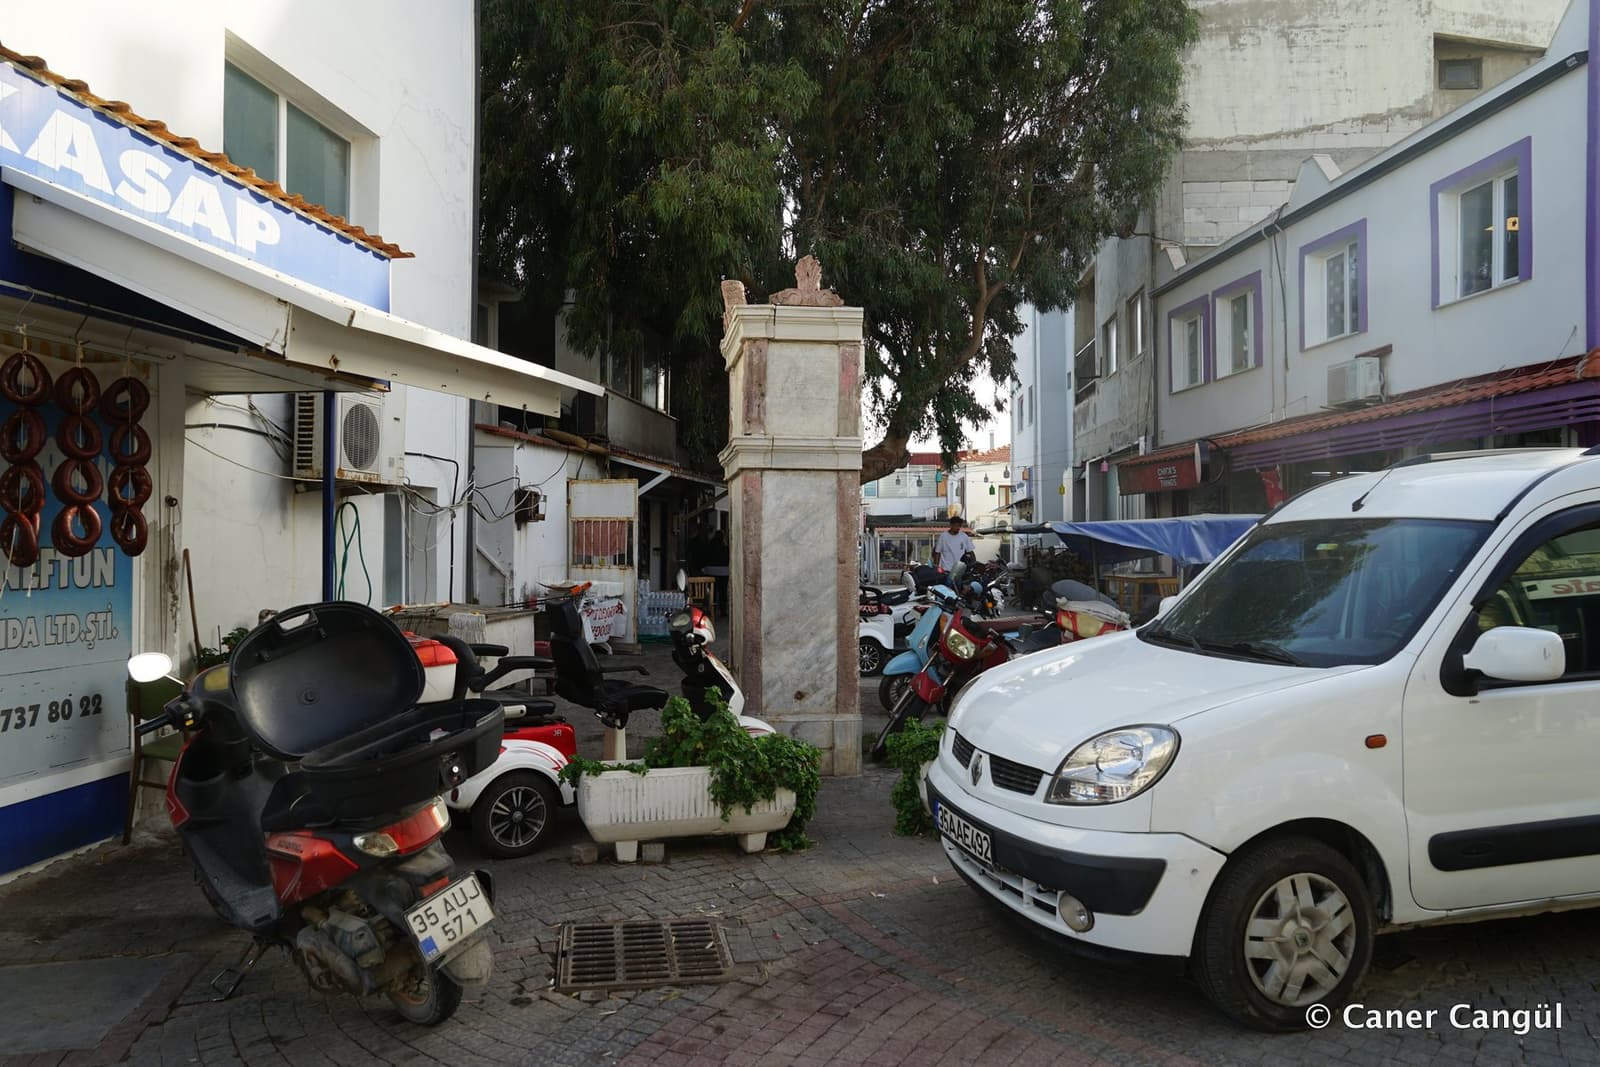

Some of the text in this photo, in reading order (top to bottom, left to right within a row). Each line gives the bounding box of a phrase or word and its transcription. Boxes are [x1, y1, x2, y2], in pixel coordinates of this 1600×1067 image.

[1, 694, 103, 732] 737 80 22
[413, 879, 481, 934] 35 AUJ
[441, 908, 479, 942] 571
